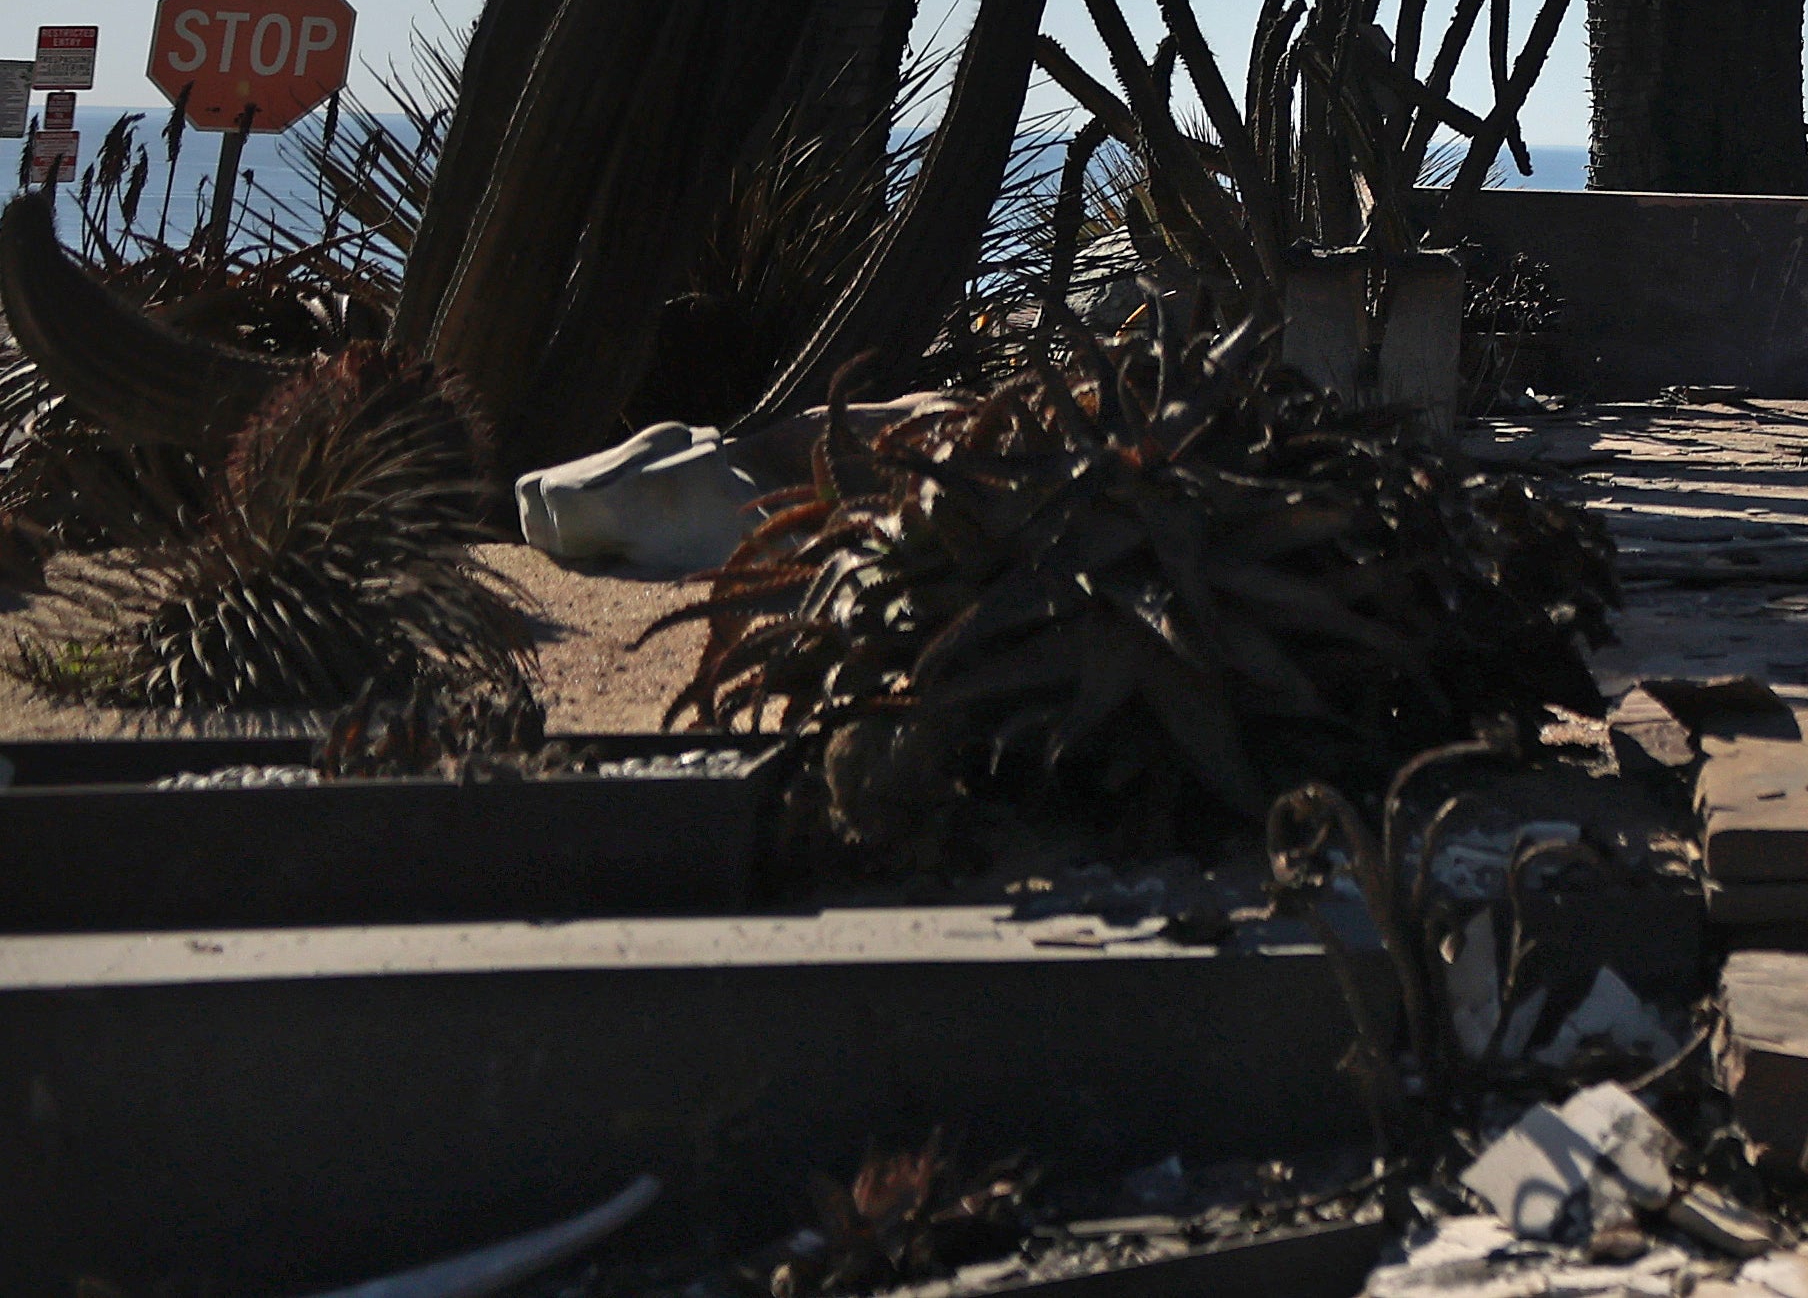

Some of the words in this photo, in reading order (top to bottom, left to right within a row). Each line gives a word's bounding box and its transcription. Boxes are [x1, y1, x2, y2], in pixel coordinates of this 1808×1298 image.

[41, 28, 96, 37] RESTRICTED
[53, 37, 81, 46] ENTRY
[168, 9, 338, 76] STOP
